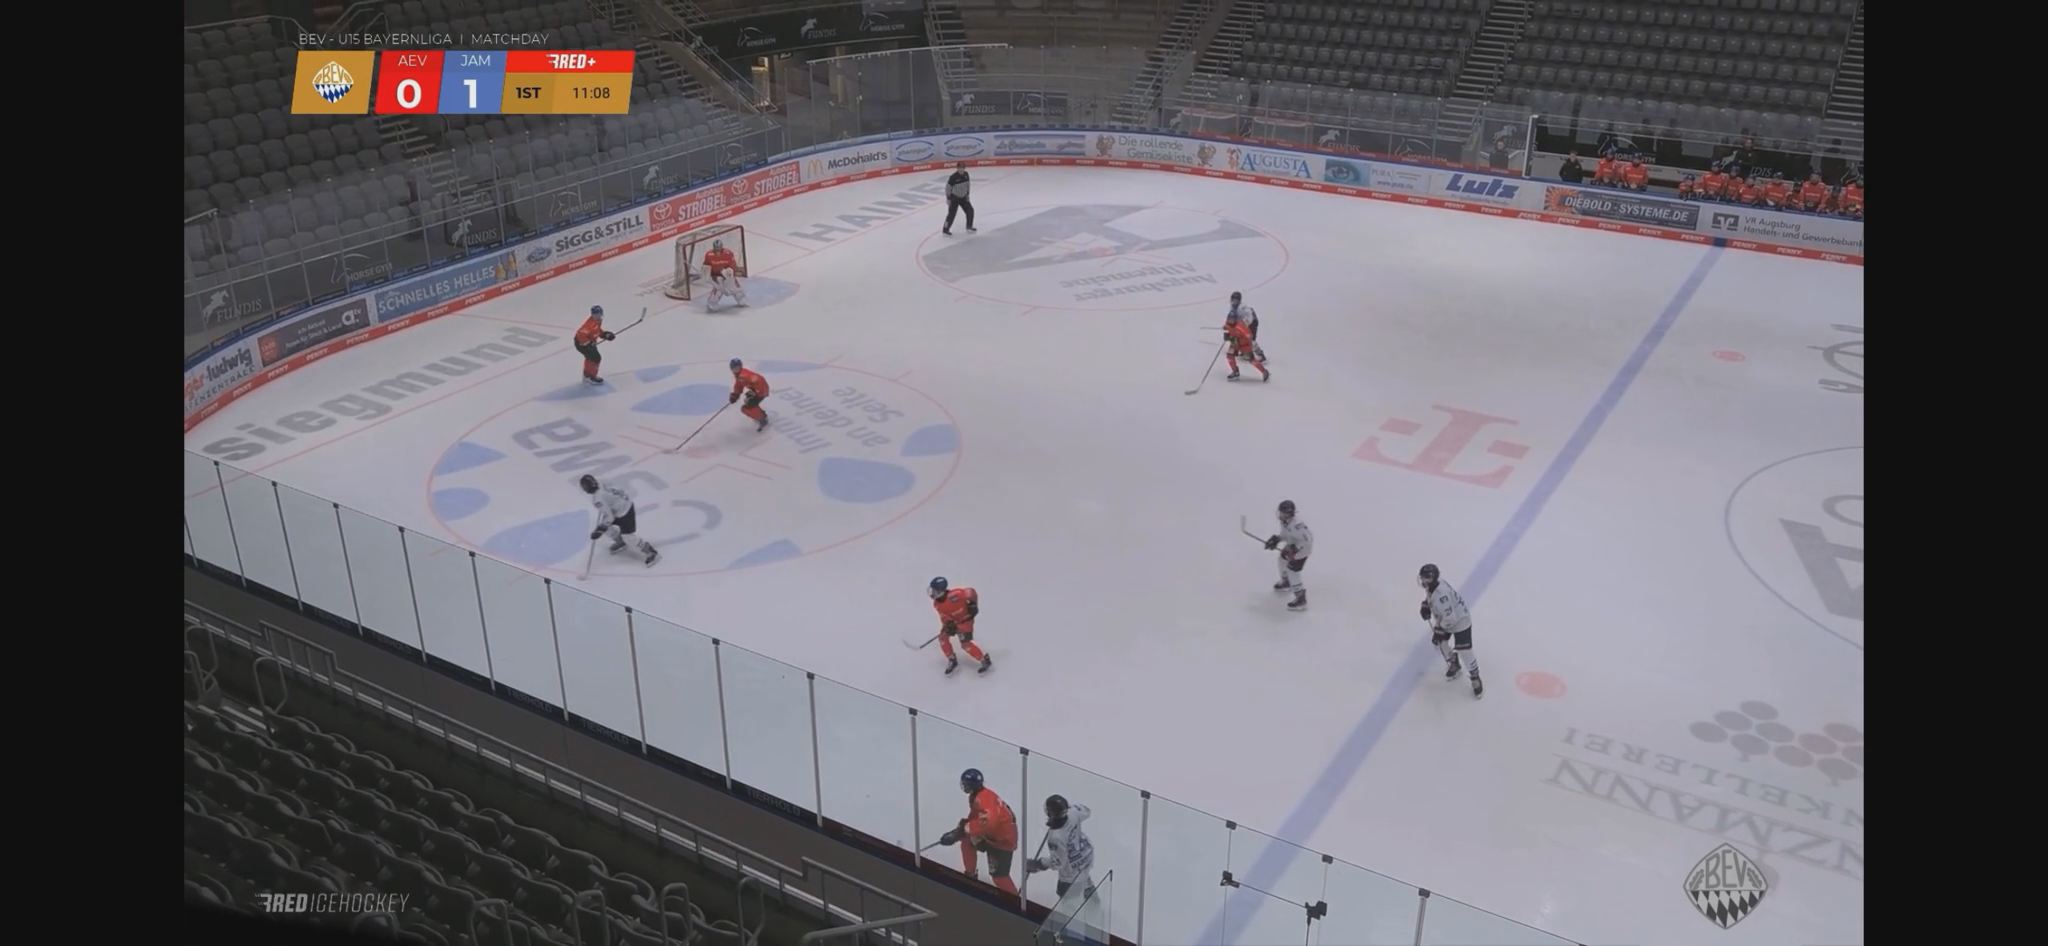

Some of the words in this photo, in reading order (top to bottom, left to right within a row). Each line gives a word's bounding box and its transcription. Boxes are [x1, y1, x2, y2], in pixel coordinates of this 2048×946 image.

[808, 29, 837, 39] FUNDIS
[1119, 135, 1138, 146] Die
[1140, 138, 1184, 151] rollende
[828, 151, 888, 169] McDonald's
[1127, 148, 1194, 164] Gemüsekiste
[769, 164, 797, 176] Autohaus
[1240, 153, 1312, 179] AUGUSTA
[754, 171, 799, 197] STROBEL
[1446, 173, 1519, 199] Lutz
[678, 193, 726, 221] STROBEL
[788, 173, 989, 243] HAIME
[1565, 196, 1612, 212] DIEBOLD
[1619, 204, 1690, 222] SYSTEME.DE
[1557, 217, 1580, 225] PENNY
[1598, 222, 1622, 230] PENNY
[1744, 216, 1757, 225] VR
[1758, 218, 1801, 232] Augsburg
[1639, 228, 1662, 236] PENNY
[1681, 233, 1705, 242] PENNY
[1744, 226, 1782, 238] Handels-
[1783, 231, 1800, 240] und
[1733, 241, 1758, 249] PENNY
[1777, 247, 1802, 256] PENNY
[1821, 253, 1848, 262] PENNY
[378, 280, 451, 314] SCHNELLES
[454, 265, 496, 289] HELLES
[465, 293, 485, 305] PENNY
[217, 299, 262, 323] FUNDIS
[427, 306, 449, 318] PENNY
[388, 319, 410, 332] PENNY
[203, 326, 561, 462] siegmund
[831, 386, 905, 423] Seite
[846, 426, 891, 448] an
